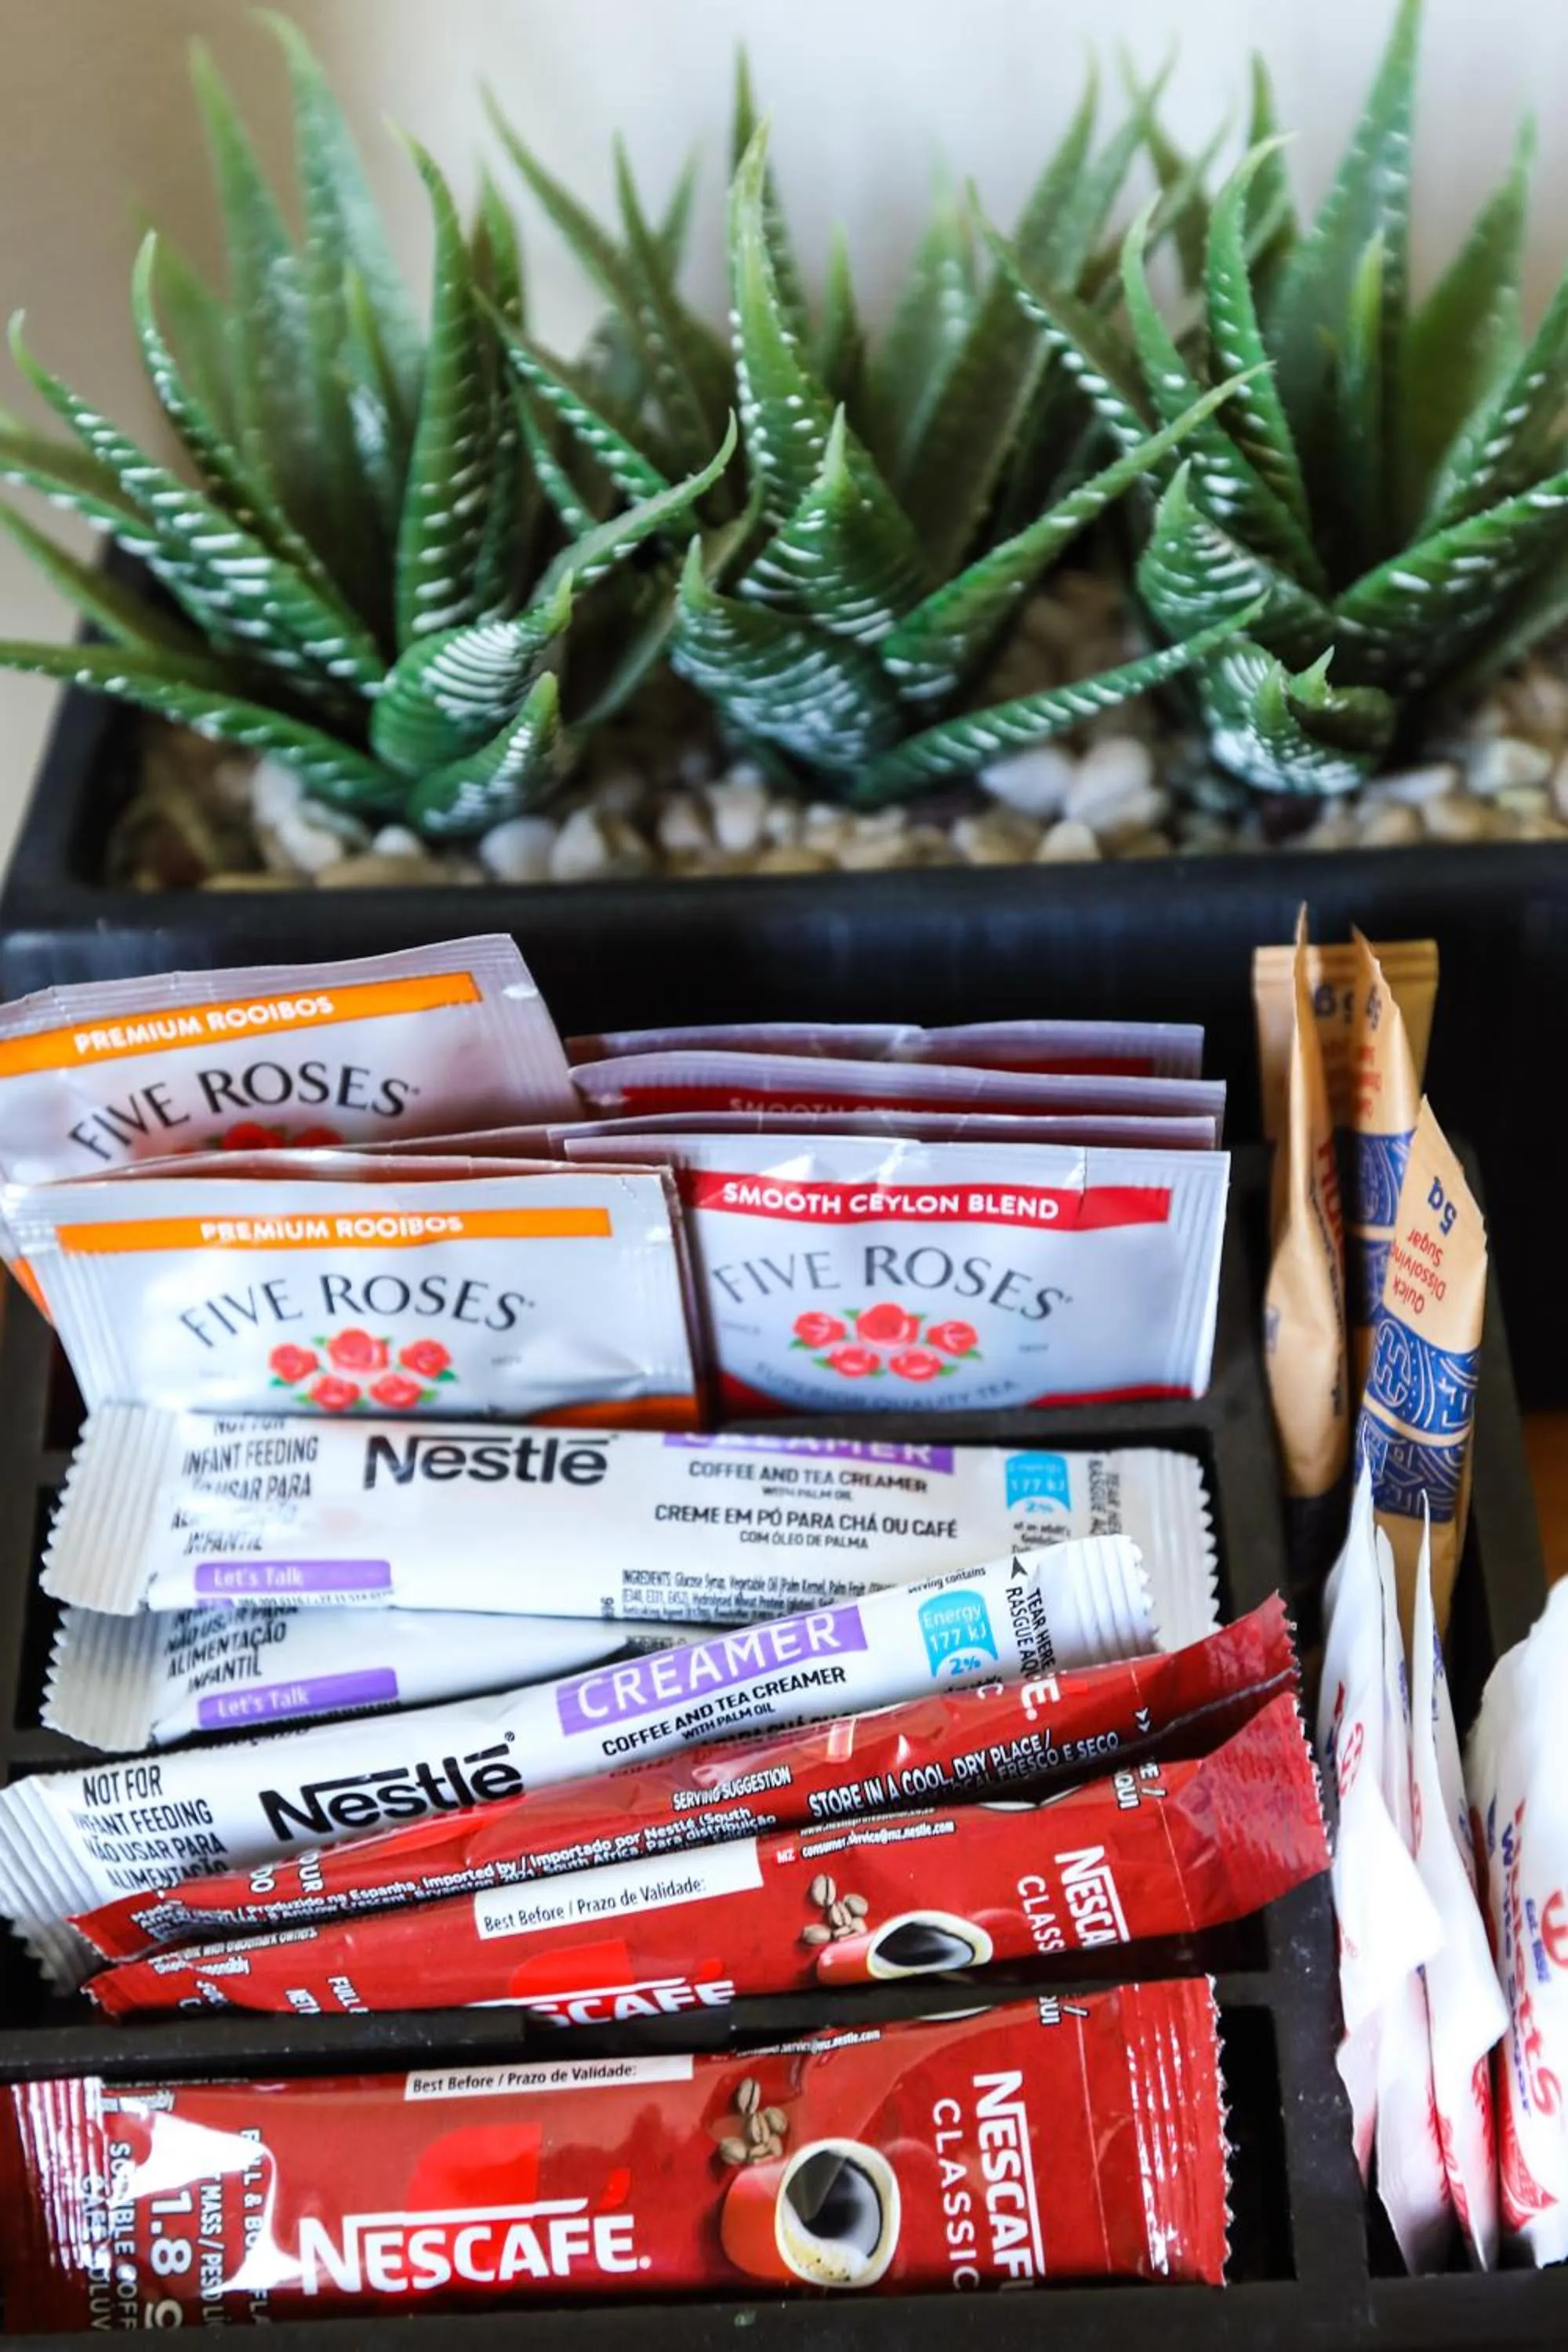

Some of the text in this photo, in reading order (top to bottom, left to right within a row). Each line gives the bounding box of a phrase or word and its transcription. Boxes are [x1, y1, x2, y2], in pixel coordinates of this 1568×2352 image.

[74, 996, 335, 1053] PREMIUM ROOIBOS
[68, 1062, 412, 1161] FIVE ROSES
[723, 1181, 1059, 1220] SMOOTH CEYLON BLEND
[1428, 1176, 1457, 1236] 5g
[201, 1216, 463, 1242] PREMIUM ROOIBOS
[1407, 1229, 1443, 1268] Sugar
[711, 1246, 1065, 1323] FIVE ROSES
[1392, 1276, 1425, 1314] Quick
[180, 1273, 527, 1348] FIVE ROSES
[182, 1435, 318, 1475] INFANT FEEDING
[363, 1435, 610, 1490] Nestlé
[689, 1461, 927, 1494] COFFEE AND TEA CREAMER
[266, 1471, 312, 1502] PARA
[655, 1504, 958, 1539] CREME EM PÓ PARA CHÁ OU CAFÉ
[739, 1529, 869, 1550] COM ÓLEO DE PALMA
[213, 1567, 304, 1588] Let's Talk
[945, 1566, 986, 1585] contains
[922, 1603, 982, 1631] Energy
[930, 1621, 988, 1653] 177 kJ
[1006, 1586, 1040, 1682] RASGUE AQU
[1026, 1587, 1047, 1632] TEAR
[1037, 1628, 1056, 1671] HERE
[167, 1621, 287, 1680] ALIMENTAÇÃO
[187, 1650, 263, 1694] INFANTIL
[577, 1612, 841, 1719] CREAMER
[949, 1655, 982, 1675] 2%
[217, 1687, 310, 1719] Let's Talk
[601, 1724, 673, 1757] COFFEE
[674, 1704, 714, 1730] AND
[715, 1690, 750, 1715] TEA
[753, 1666, 848, 1700] CREAMER
[681, 1720, 717, 1741] WITH
[716, 1709, 753, 1728] PALM
[754, 1701, 776, 1717] OIL
[808, 1732, 1043, 1819] STORE IN A COOL, DRY PLACE
[997, 1750, 1059, 1780] FRESCO
[1062, 1744, 1074, 1762] E
[1076, 1730, 1120, 1759] SECO
[82, 1764, 163, 1807] NOT FOR
[259, 1744, 524, 1842] Nestlé
[672, 1766, 792, 1812] SERVING SUGGESTION
[1114, 1768, 1142, 1810] QUI
[129, 1798, 213, 1835] FEEDING
[118, 1837, 175, 1863] USAR
[169, 1831, 229, 1859] PARA
[422, 1863, 495, 1888] Imported
[529, 1838, 612, 1867] Importado
[614, 1833, 641, 1851] por
[483, 1876, 706, 1933] Best Before Prazo de Validade:
[1017, 1875, 1066, 1954] CLASS
[1054, 1845, 1131, 1947] NESCA
[412, 2063, 637, 2094] Best Before Prazo de Validade:
[933, 2098, 979, 2292] CLASSIC
[972, 2070, 1047, 2289] NESCAF
[150, 2190, 194, 2276] 1.8
[200, 2184, 223, 2236] MASS
